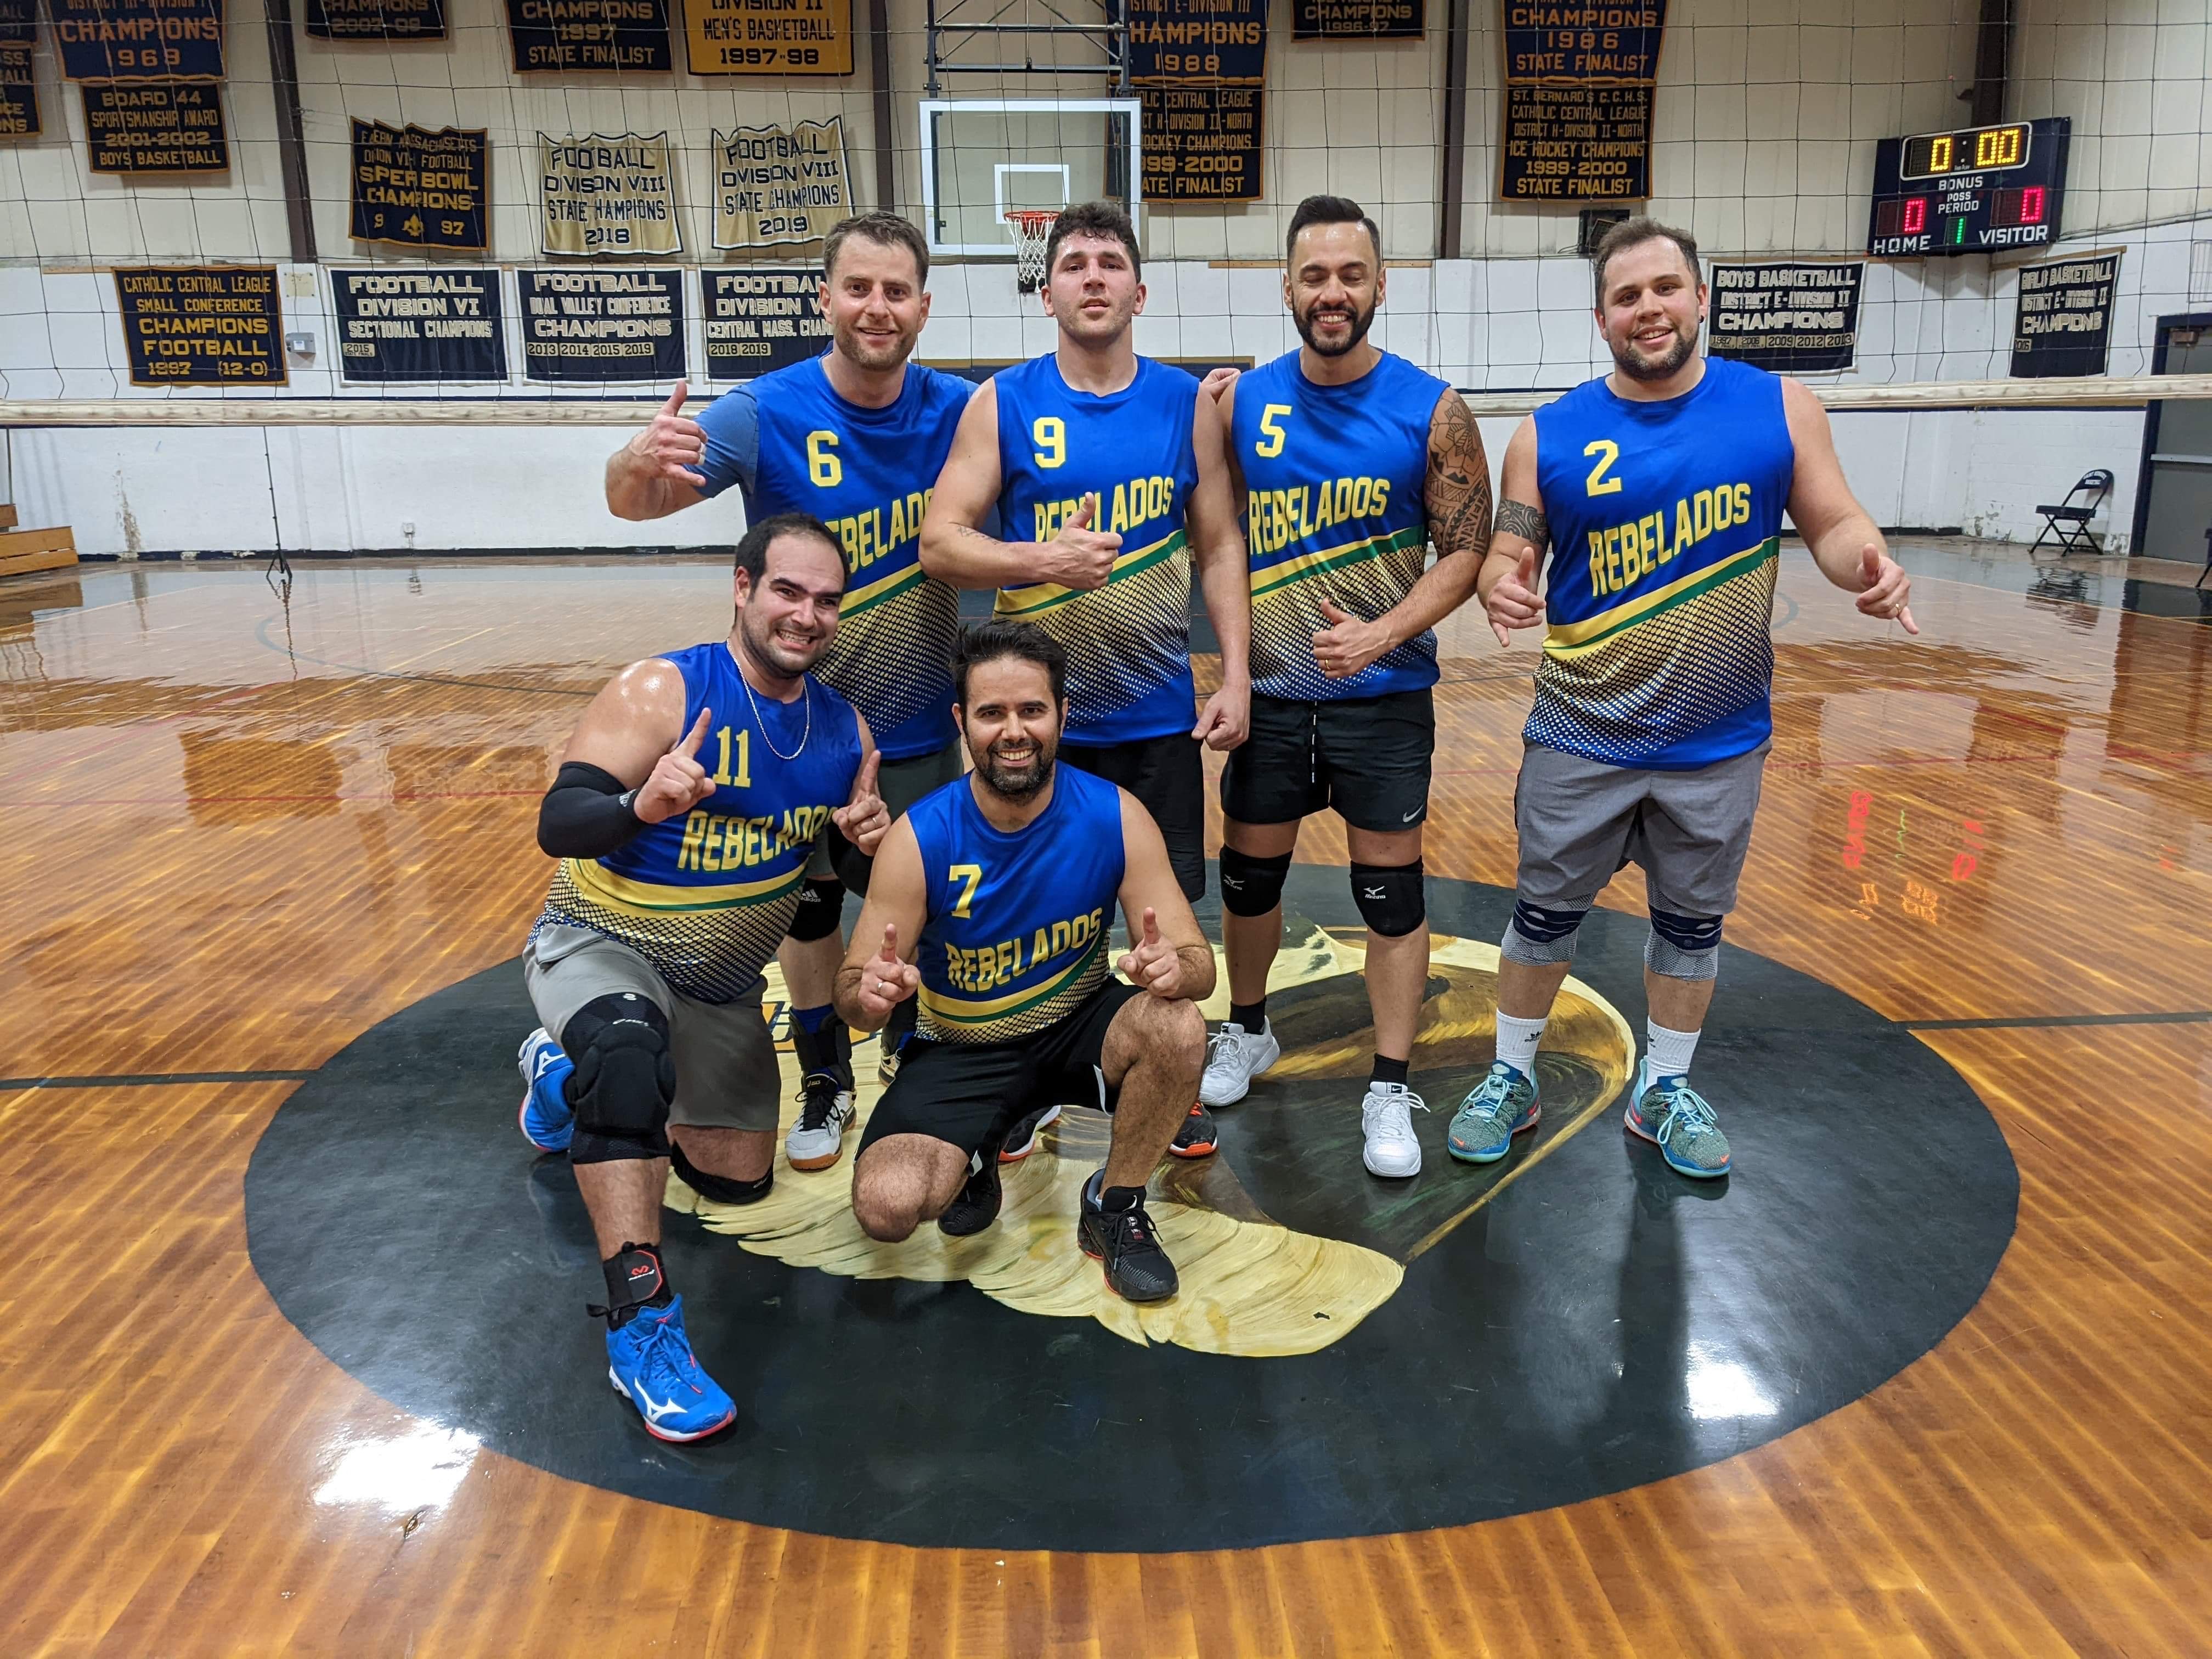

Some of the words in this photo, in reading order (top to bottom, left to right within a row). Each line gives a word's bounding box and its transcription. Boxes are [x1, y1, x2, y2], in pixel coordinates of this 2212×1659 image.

[522, 2, 653, 19] CHAMPIONS
[1131, 0, 1168, 13] ISTRICT
[1305, 5, 1413, 20] CHAMPIONS
[1512, 8, 1658, 27] CHAMPIONS
[60, 17, 218, 42] CHAMPIONS
[560, 23, 618, 41] 1997
[703, 16, 741, 40] MEN'S
[747, 18, 835, 41] BASKETBALL
[1114, 21, 1261, 44] HAMPIONS
[1547, 31, 1620, 49] 1986
[529, 46, 576, 64] STATE
[583, 46, 655, 64] FINALIST
[719, 48, 819, 65] 1997-98
[1155, 53, 1220, 72] 1988
[1516, 53, 1565, 71] STATE
[1575, 54, 1649, 71] FINALIST
[101, 91, 168, 107] BOARD
[176, 90, 202, 105] 44
[1166, 92, 1210, 109] CENTRAL
[1216, 91, 1253, 108] LEAGUE
[1513, 89, 1529, 101] ST.
[1533, 89, 1594, 103] BERNARD'S
[91, 110, 179, 128] SPORTSMANSHIP
[184, 109, 218, 126] AWARD
[1511, 105, 1556, 120] CATHOLIC
[1560, 105, 1605, 121] CENTRAL
[1610, 105, 1648, 120] LEAGUE
[105, 131, 211, 147] 2001-2002
[1514, 122, 1548, 137] DISTRICT
[725, 133, 828, 166] FOOTBALL
[1187, 134, 1252, 151] CHAMPIONS
[1509, 139, 1527, 157] ICE
[1532, 140, 1577, 157] HOCKEY
[1582, 141, 1645, 158] CHAMPIONS
[99, 151, 132, 165] BOYS
[137, 149, 221, 165] BASKETBALL
[421, 154, 474, 171] FOOTBALL
[551, 146, 656, 171] FOOBALL
[1141, 155, 1243, 173] 99-2000
[801, 159, 839, 178] VIII
[1526, 160, 1627, 176] 1999-2000
[421, 171, 479, 190] BOWL
[627, 174, 666, 193] VIII
[1141, 176, 1169, 194] ATE
[1176, 176, 1245, 194] FINALIST
[1516, 178, 1562, 195] STATE
[1567, 178, 1634, 195] FINALIST
[1938, 176, 1984, 191] BONUS
[1946, 191, 1972, 202] POSS
[2022, 187, 2042, 223] 0
[595, 198, 667, 221] HAMPIONS
[1904, 200, 1923, 233] 0
[1937, 200, 1980, 215] PERIOD
[441, 219, 465, 236] 97
[758, 216, 809, 236] 2019
[1978, 224, 2049, 245] VISITOR
[1873, 235, 1932, 255] HOME
[533, 273, 667, 292] FOOTBALL
[1716, 269, 1755, 288] BOYS
[1758, 269, 1857, 287] BASKETBALL
[2049, 261, 2112, 286] BASKETBALL
[123, 276, 173, 293] CATHOLIC
[177, 276, 227, 294] CENTRAL
[231, 276, 272, 293] LEAGUE
[348, 275, 484, 294] FOOTBALL
[136, 298, 178, 313] SMALL
[184, 298, 264, 313] CONFERENCE
[357, 297, 448, 317] DIVISION
[454, 297, 480, 316] VI
[561, 297, 603, 315] VALLEY
[606, 296, 672, 315] CONFERENCE
[715, 297, 802, 316] DIVISION
[1720, 291, 1771, 309] DISTRICT
[139, 317, 269, 335] CHAMPIONS
[348, 320, 420, 338] SECTIONAL
[424, 320, 493, 338] CHAMPIONS
[534, 319, 672, 338] CHAMPIONS
[707, 320, 759, 338] CENTRAL
[762, 319, 797, 337] MASS.
[1718, 311, 1844, 331] CHAMPIONS
[143, 339, 268, 357] FOOTBALL
[346, 344, 369, 353] 2015
[528, 343, 556, 356] 2013
[561, 344, 589, 355] 2014
[592, 344, 620, 356] 2015
[624, 343, 651, 355] 2019
[710, 344, 738, 354] 2018
[741, 343, 768, 354] 2019
[1741, 336, 1760, 345] 2006
[1768, 336, 1793, 347] 2009
[1797, 336, 1823, 347] 2012
[1827, 335, 1852, 347] 2013
[148, 362, 193, 375] 1997
[1255, 404, 1293, 458] 5
[1034, 417, 1065, 469] 9
[806, 431, 842, 487] 6
[1584, 439, 1622, 496] 2
[1249, 477, 1391, 555] REBELADOS
[1588, 483, 1751, 597] REBELADOS
[713, 725, 751, 788] 11
[949, 864, 983, 919] 7
[945, 907, 1103, 992] REBELADOS
